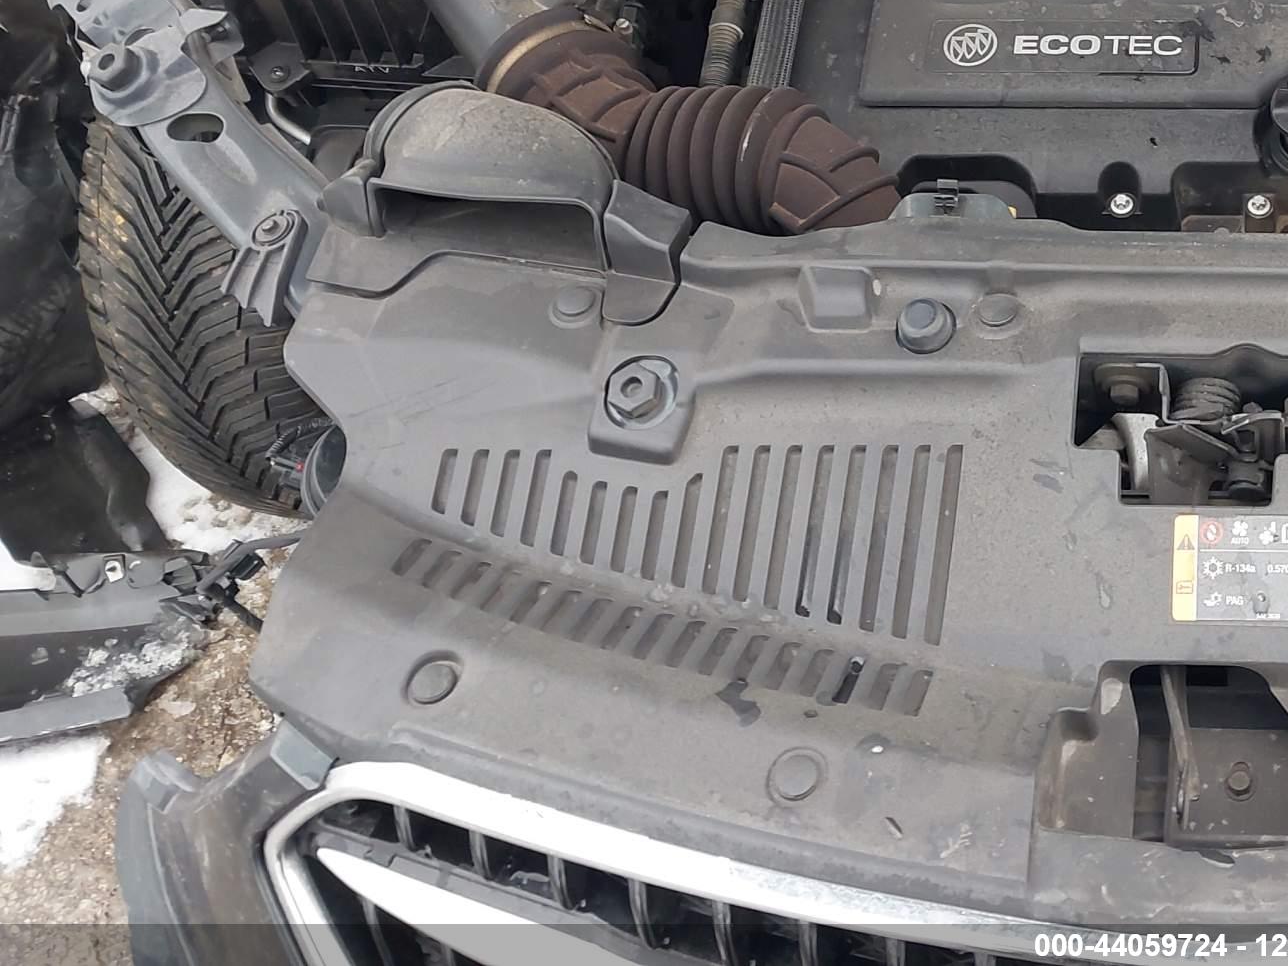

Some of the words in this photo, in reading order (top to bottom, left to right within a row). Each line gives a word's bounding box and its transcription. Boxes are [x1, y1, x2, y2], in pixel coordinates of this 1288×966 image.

[1013, 34, 1183, 56] ECOTEC
[1231, 537, 1249, 545] AUTO
[1225, 563, 1256, 573] R-134a
[1225, 595, 1244, 606] PAG
